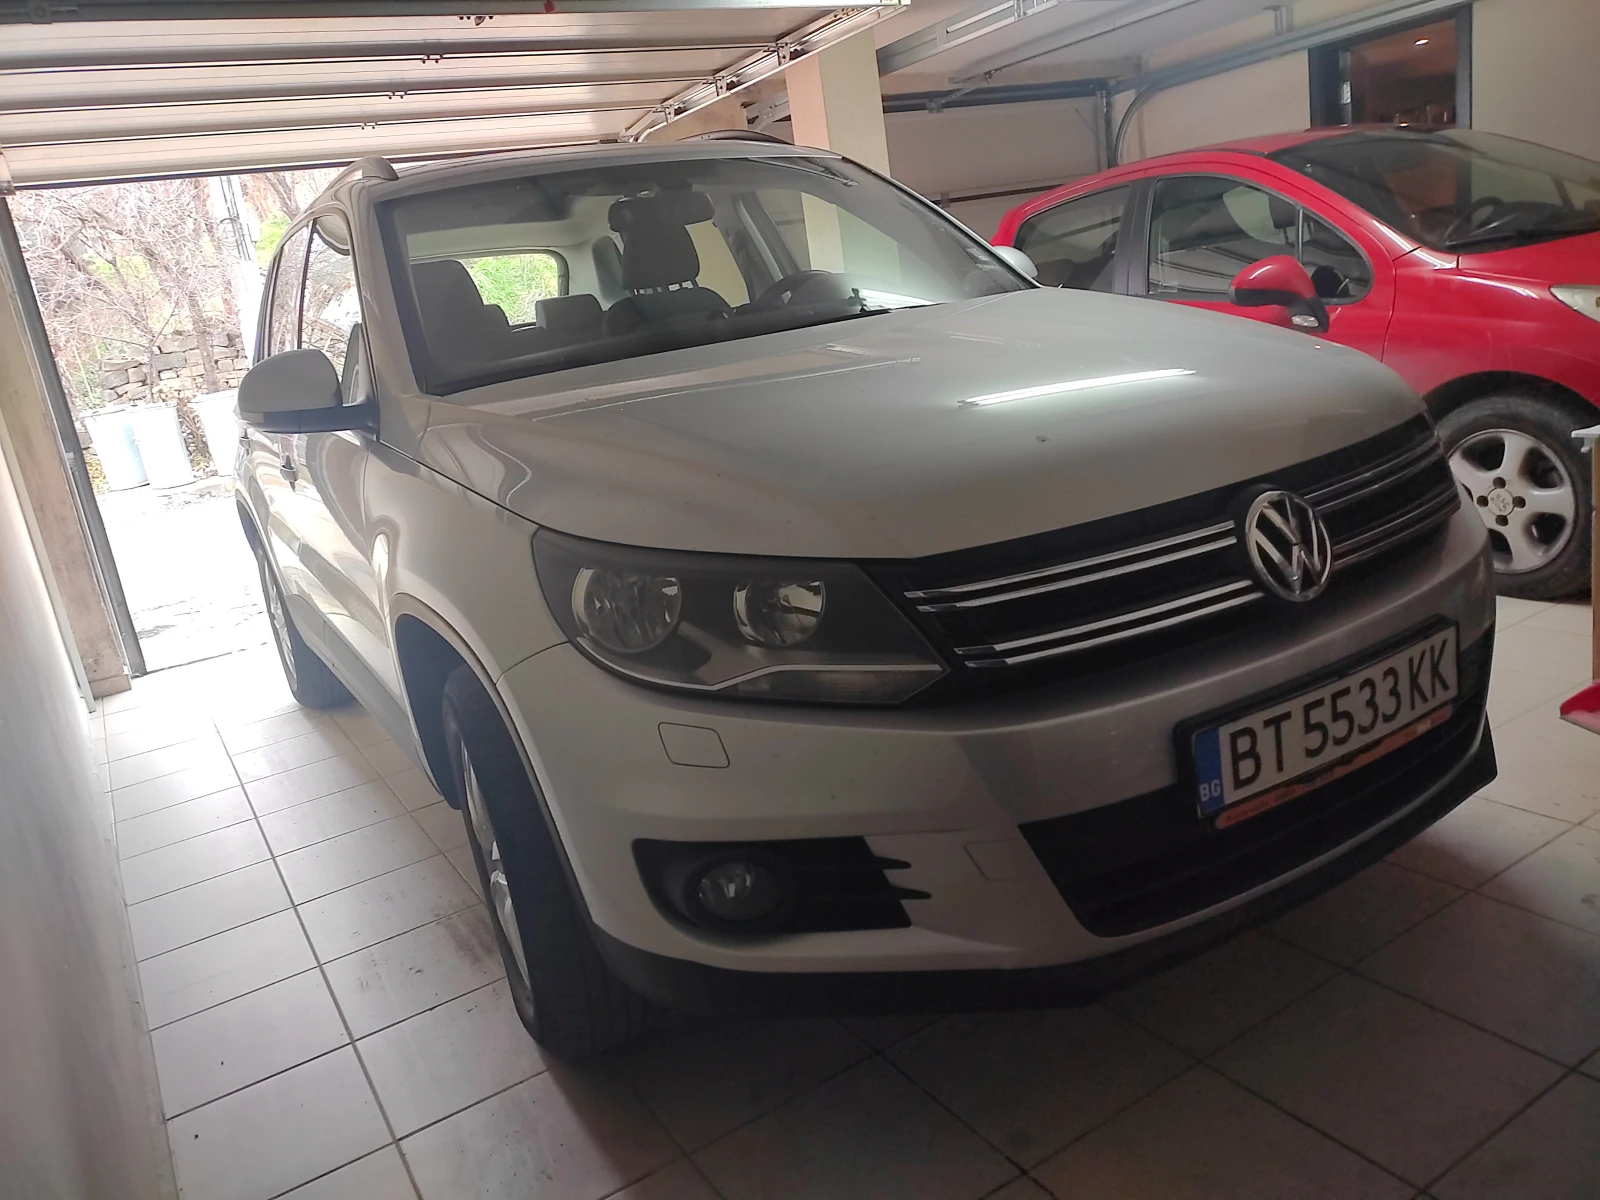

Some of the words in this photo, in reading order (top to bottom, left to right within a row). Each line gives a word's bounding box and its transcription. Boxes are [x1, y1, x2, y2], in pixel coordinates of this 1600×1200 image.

[1229, 711, 1292, 790] BT
[1303, 666, 1402, 759] 5533
[1408, 637, 1451, 712] KK
[1199, 779, 1221, 802] BG
